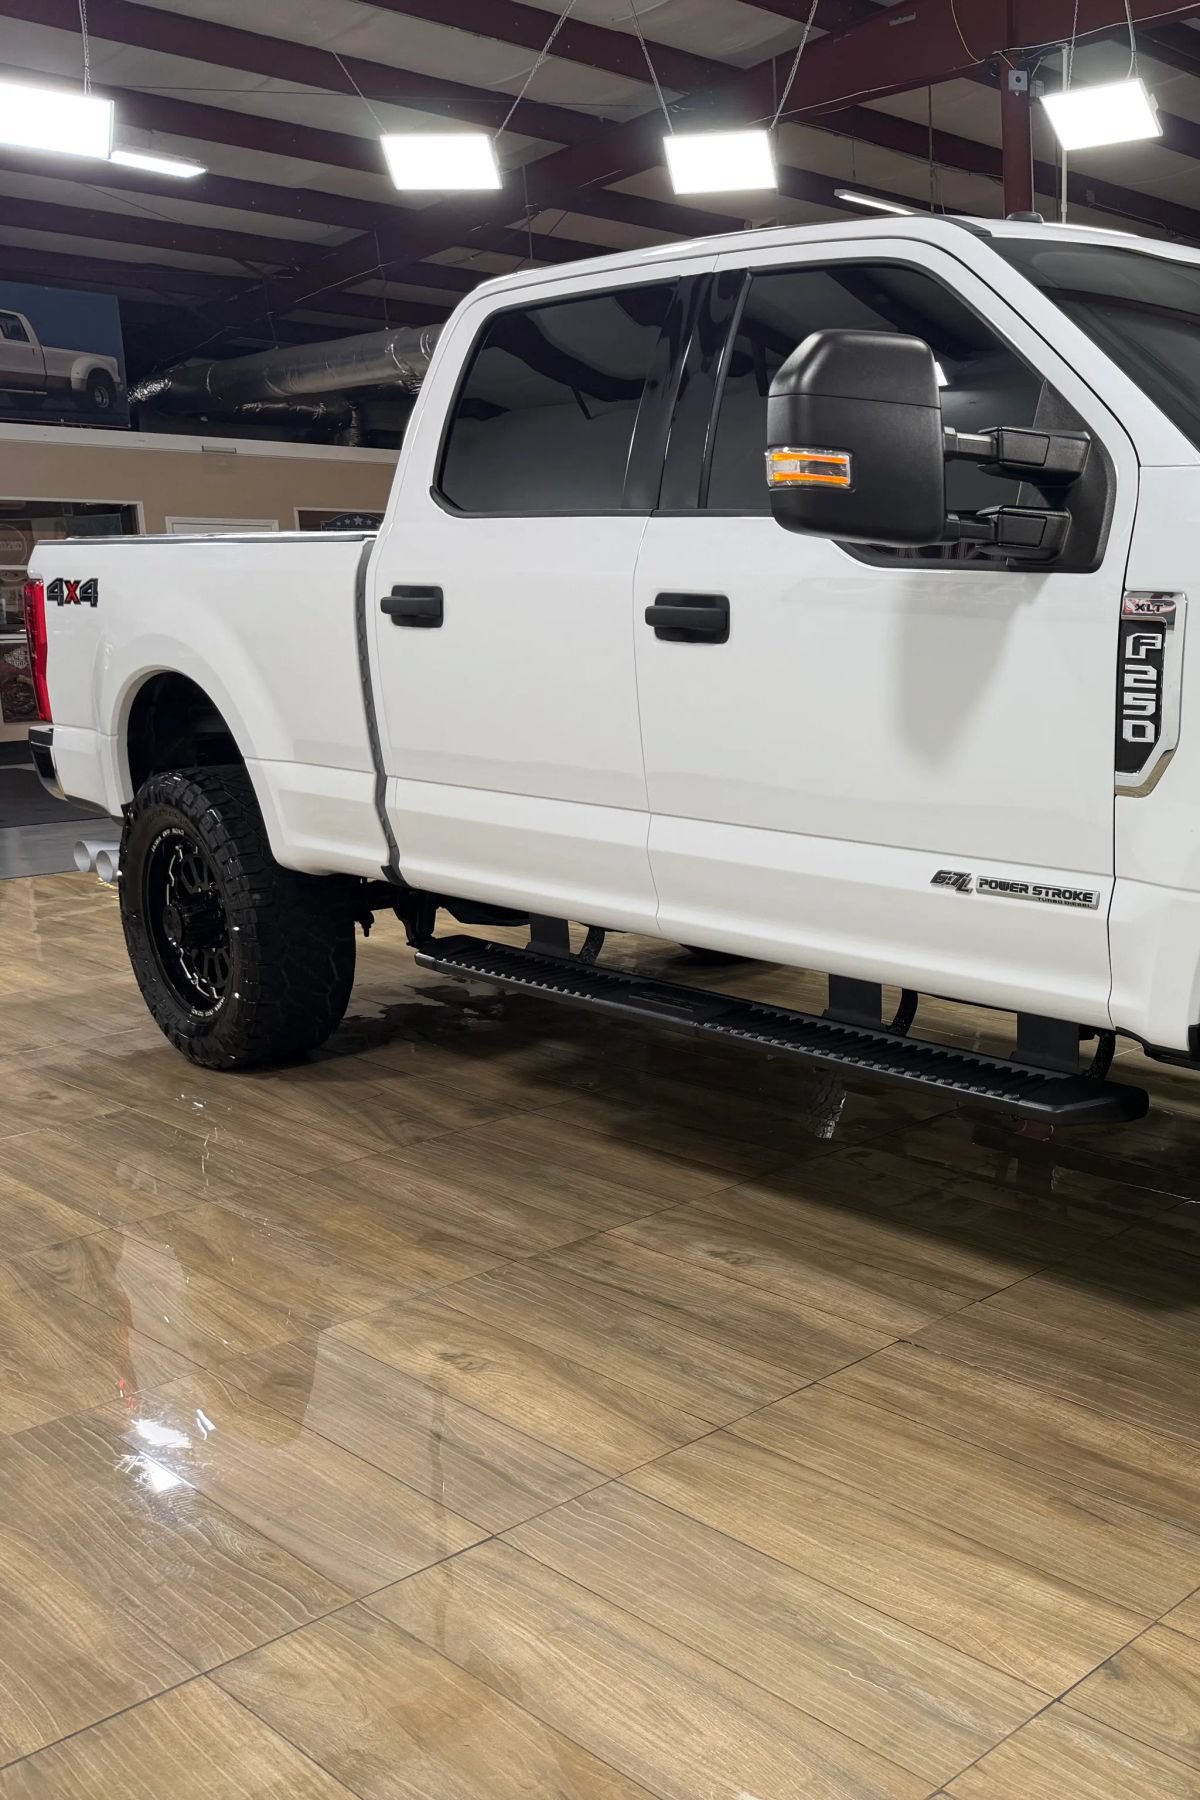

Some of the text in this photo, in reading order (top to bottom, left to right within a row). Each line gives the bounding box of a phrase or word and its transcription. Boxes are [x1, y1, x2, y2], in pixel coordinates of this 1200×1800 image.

[1135, 603, 1163, 613] XLT
[1122, 632, 1163, 743] F250
[930, 869, 1094, 903] 6.7L POWER STROKE
